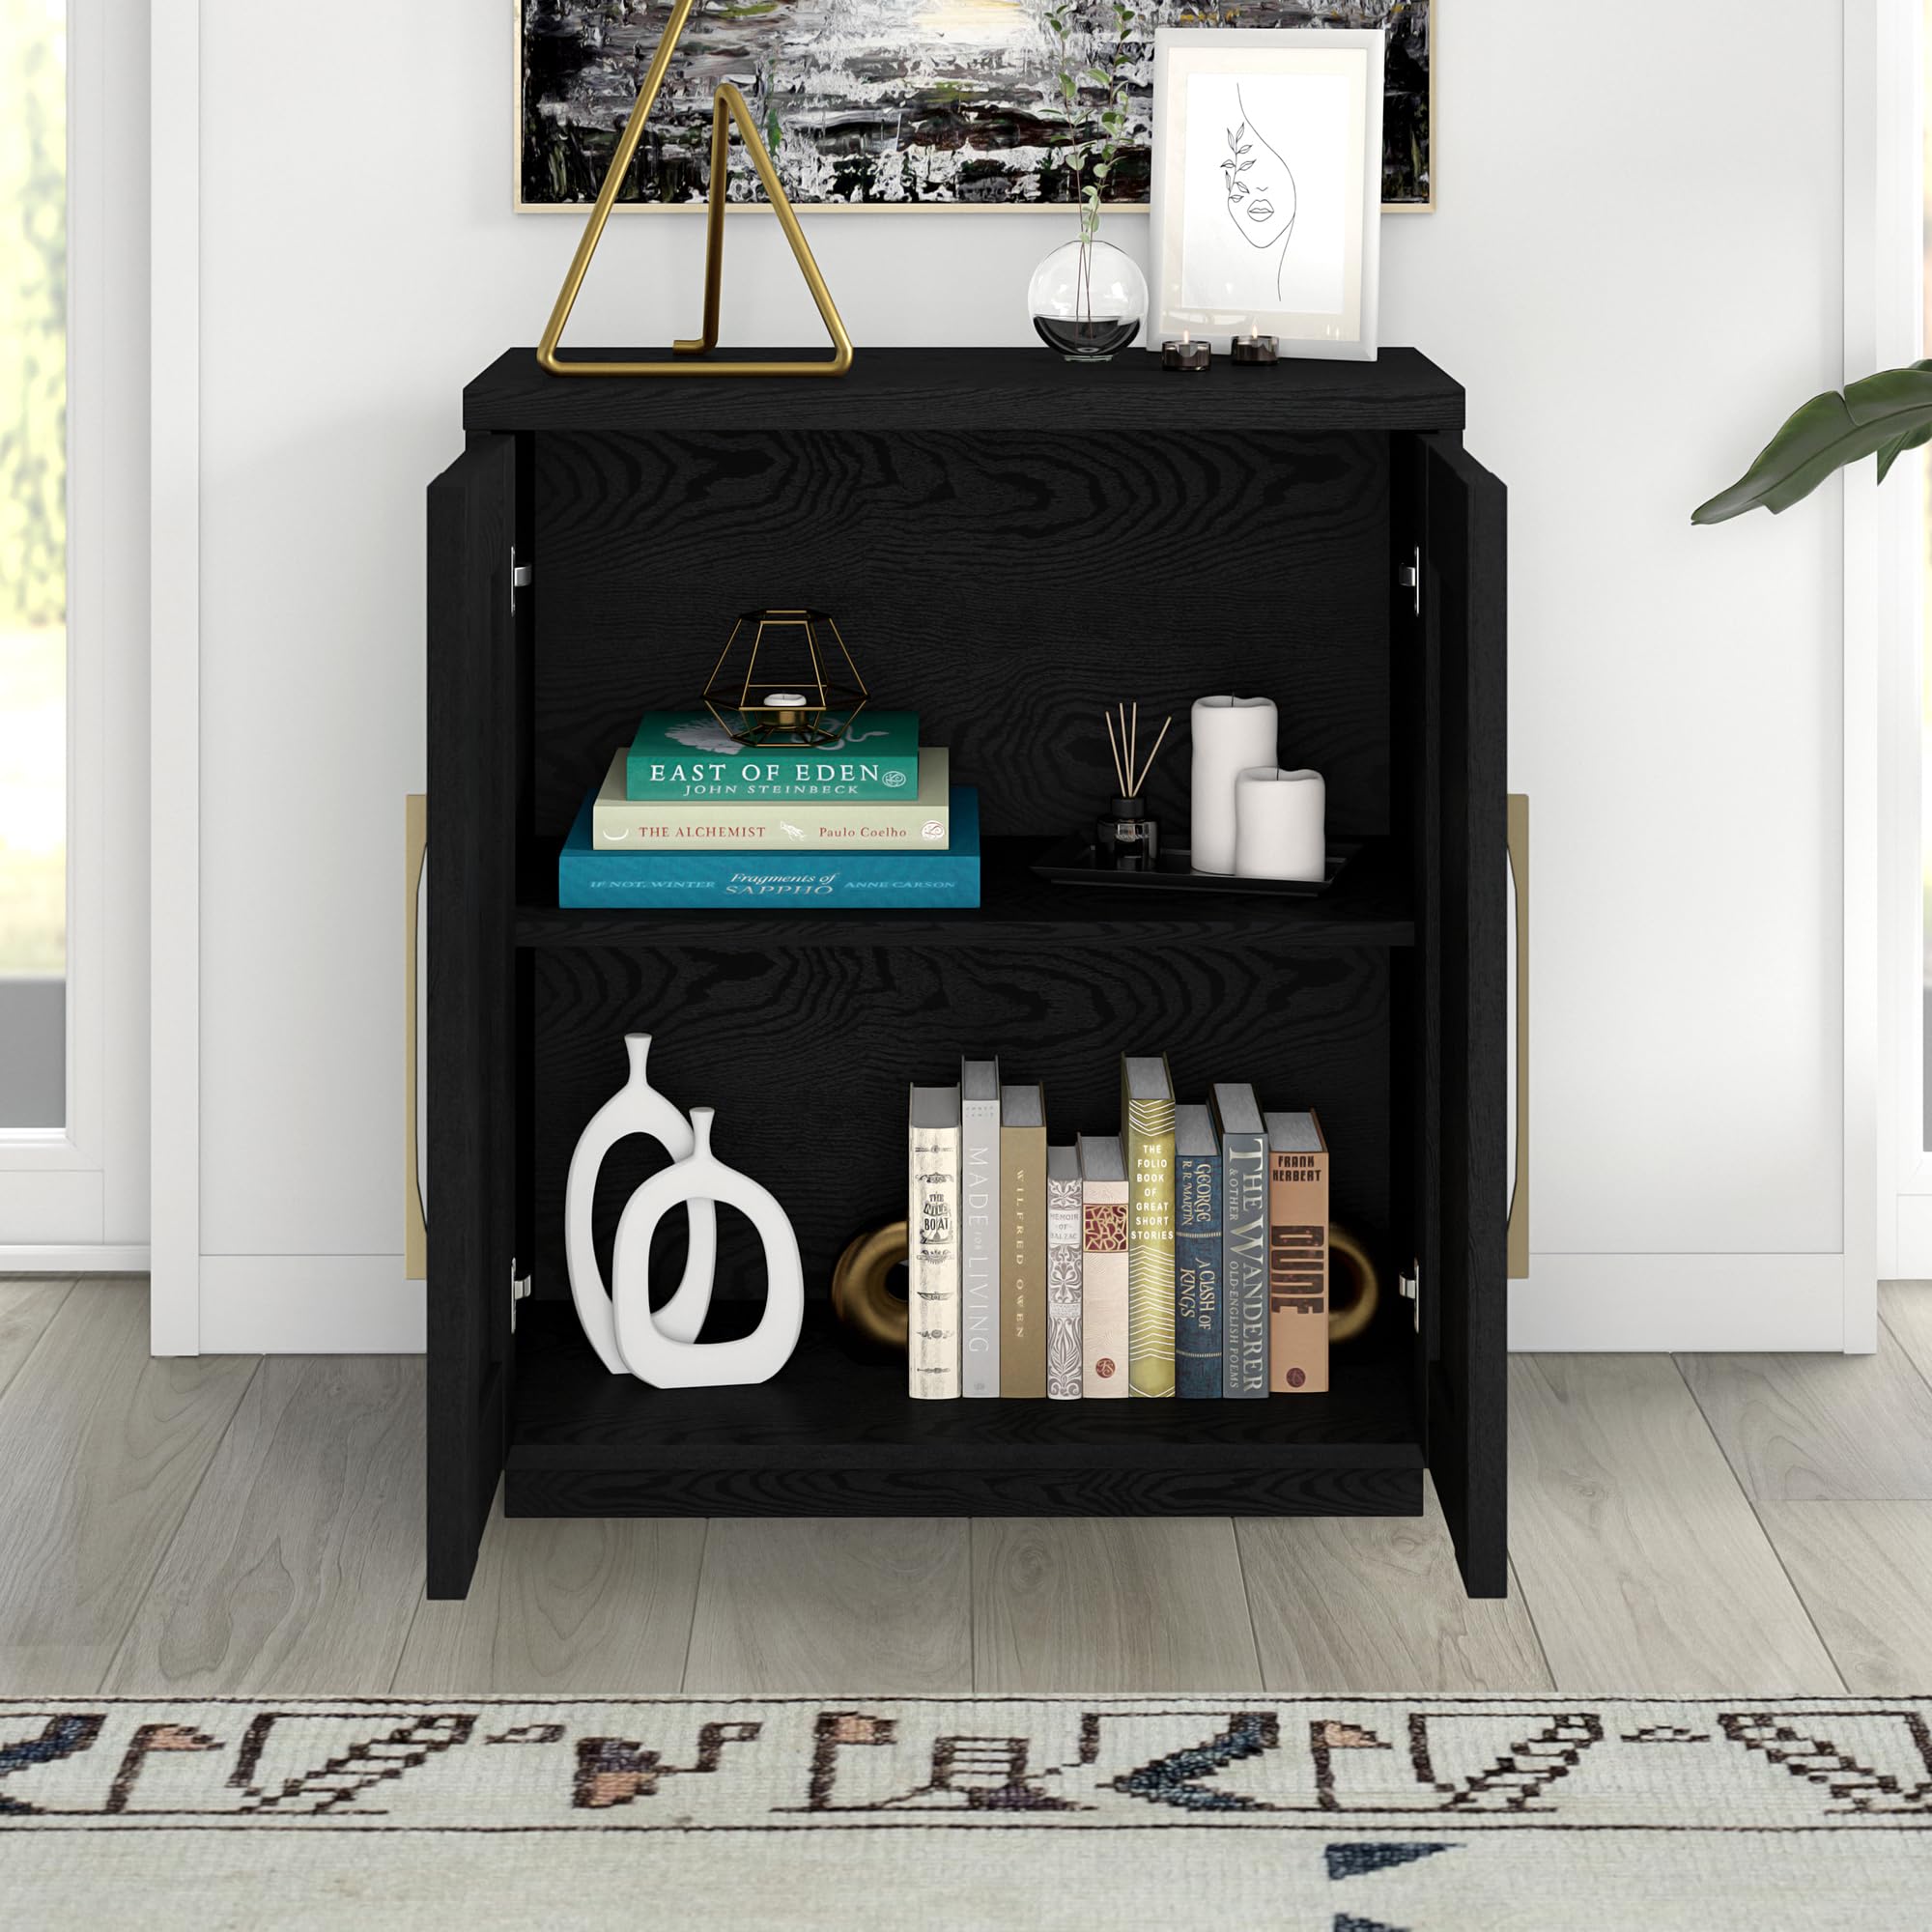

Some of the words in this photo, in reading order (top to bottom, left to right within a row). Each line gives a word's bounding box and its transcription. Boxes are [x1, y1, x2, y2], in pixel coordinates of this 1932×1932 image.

[650, 764, 725, 781] EAST
[741, 764, 780, 781] OF
[796, 764, 879, 781] EDEN
[683, 784, 737, 797] JOHN
[747, 784, 859, 795] STEINBECK
[639, 827, 669, 838] THE
[675, 827, 766, 838] ALCHEMIST
[819, 827, 856, 838] Paulo
[860, 827, 907, 838] Coelho
[730, 873, 814, 886] Fragments
[819, 873, 839, 884] of
[725, 885, 834, 895] SAPPHO
[1143, 1145, 1162, 1153] THE
[1137, 1159, 1168, 1168] FOLIO
[1278, 1155, 1315, 1168] FRANK
[1136, 1174, 1165, 1182] BOOK
[1229, 1167, 1238, 1176] &
[1229, 1138, 1264, 1212] THE
[1272, 1169, 1321, 1181] HERBERT
[968, 1148, 988, 1227] MADE
[1144, 1188, 1157, 1197] OF
[1193, 1163, 1211, 1222] GEORGE
[1135, 1202, 1169, 1211] GREAT
[1181, 1182, 1194, 1226] MARTIN
[1229, 1179, 1239, 1221] OTHER
[923, 1217, 950, 1231] BOAT
[1135, 1217, 1169, 1226] SHORT
[1130, 1231, 1174, 1239] STORIES
[1194, 1257, 1211, 1269] A
[1179, 1267, 1197, 1319] KINGS
[1199, 1270, 1215, 1312] CLASH
[968, 1257, 989, 1352] LIVING
[1229, 1213, 1264, 1392] WANDERER
[1198, 1315, 1211, 1331] OF
[1229, 1348, 1239, 1388] POEMS
